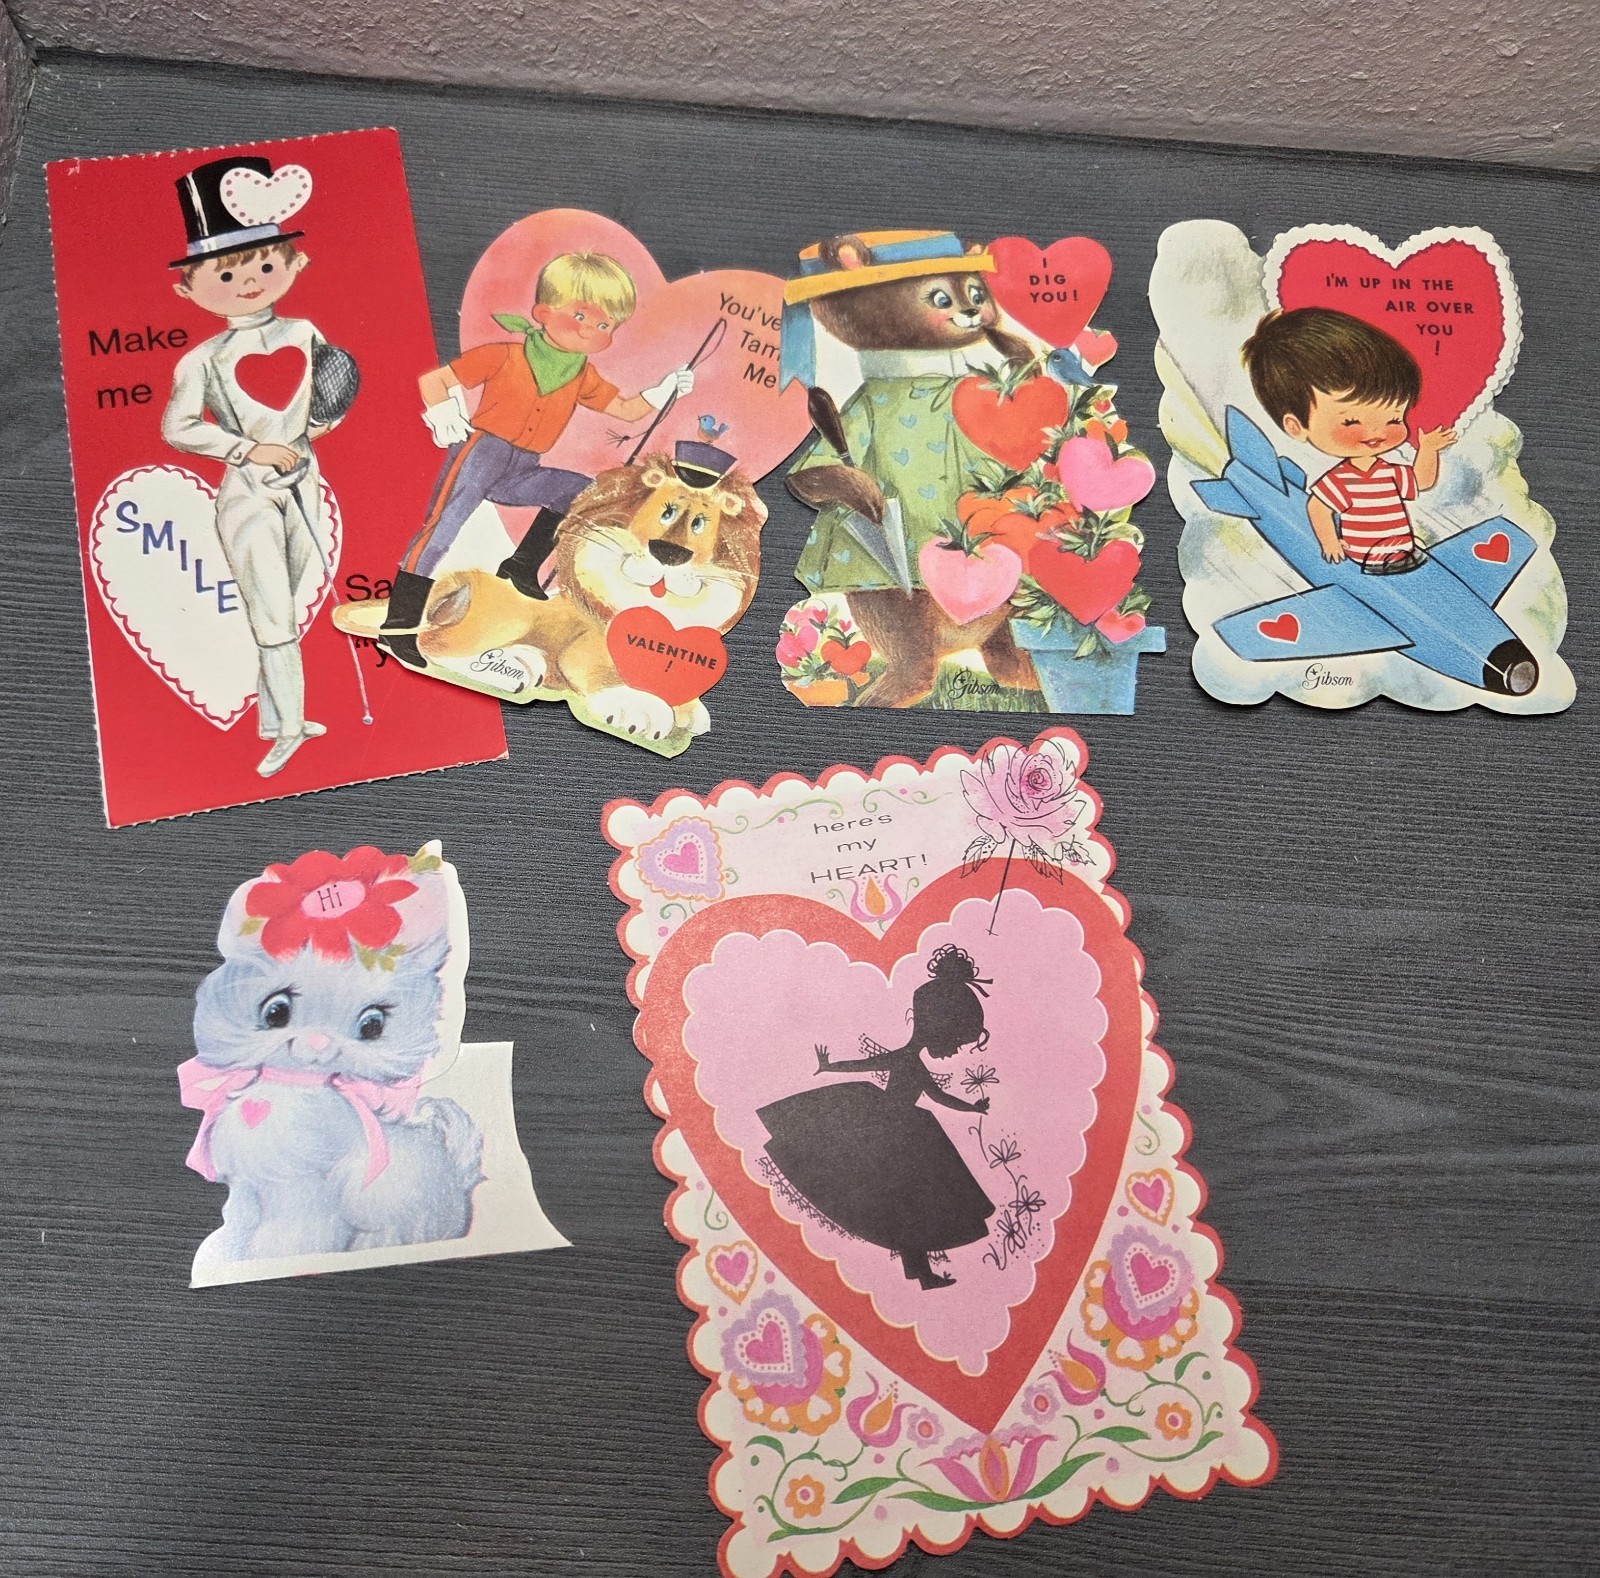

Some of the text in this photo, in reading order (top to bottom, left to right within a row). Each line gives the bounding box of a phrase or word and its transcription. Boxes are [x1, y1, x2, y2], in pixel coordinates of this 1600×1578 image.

[1042, 257, 1048, 269] I
[1029, 274, 1066, 286] DIG
[1325, 273, 1454, 292] I'M UP IN THE
[719, 292, 782, 331] You've
[1385, 300, 1475, 314] AIR OVER
[88, 325, 189, 357] Make
[1416, 323, 1453, 336] YOU
[742, 362, 777, 389] Me
[97, 383, 153, 410] me
[116, 500, 239, 614] SMILE
[469, 648, 525, 680] Gibson
[627, 633, 717, 670] VALENTINE
[947, 668, 1001, 700] Gibson
[1301, 662, 1354, 691] Gibson
[813, 813, 893, 835] here's
[836, 838, 877, 853] my
[810, 853, 928, 884] HEART!
[317, 884, 343, 912] Hi
